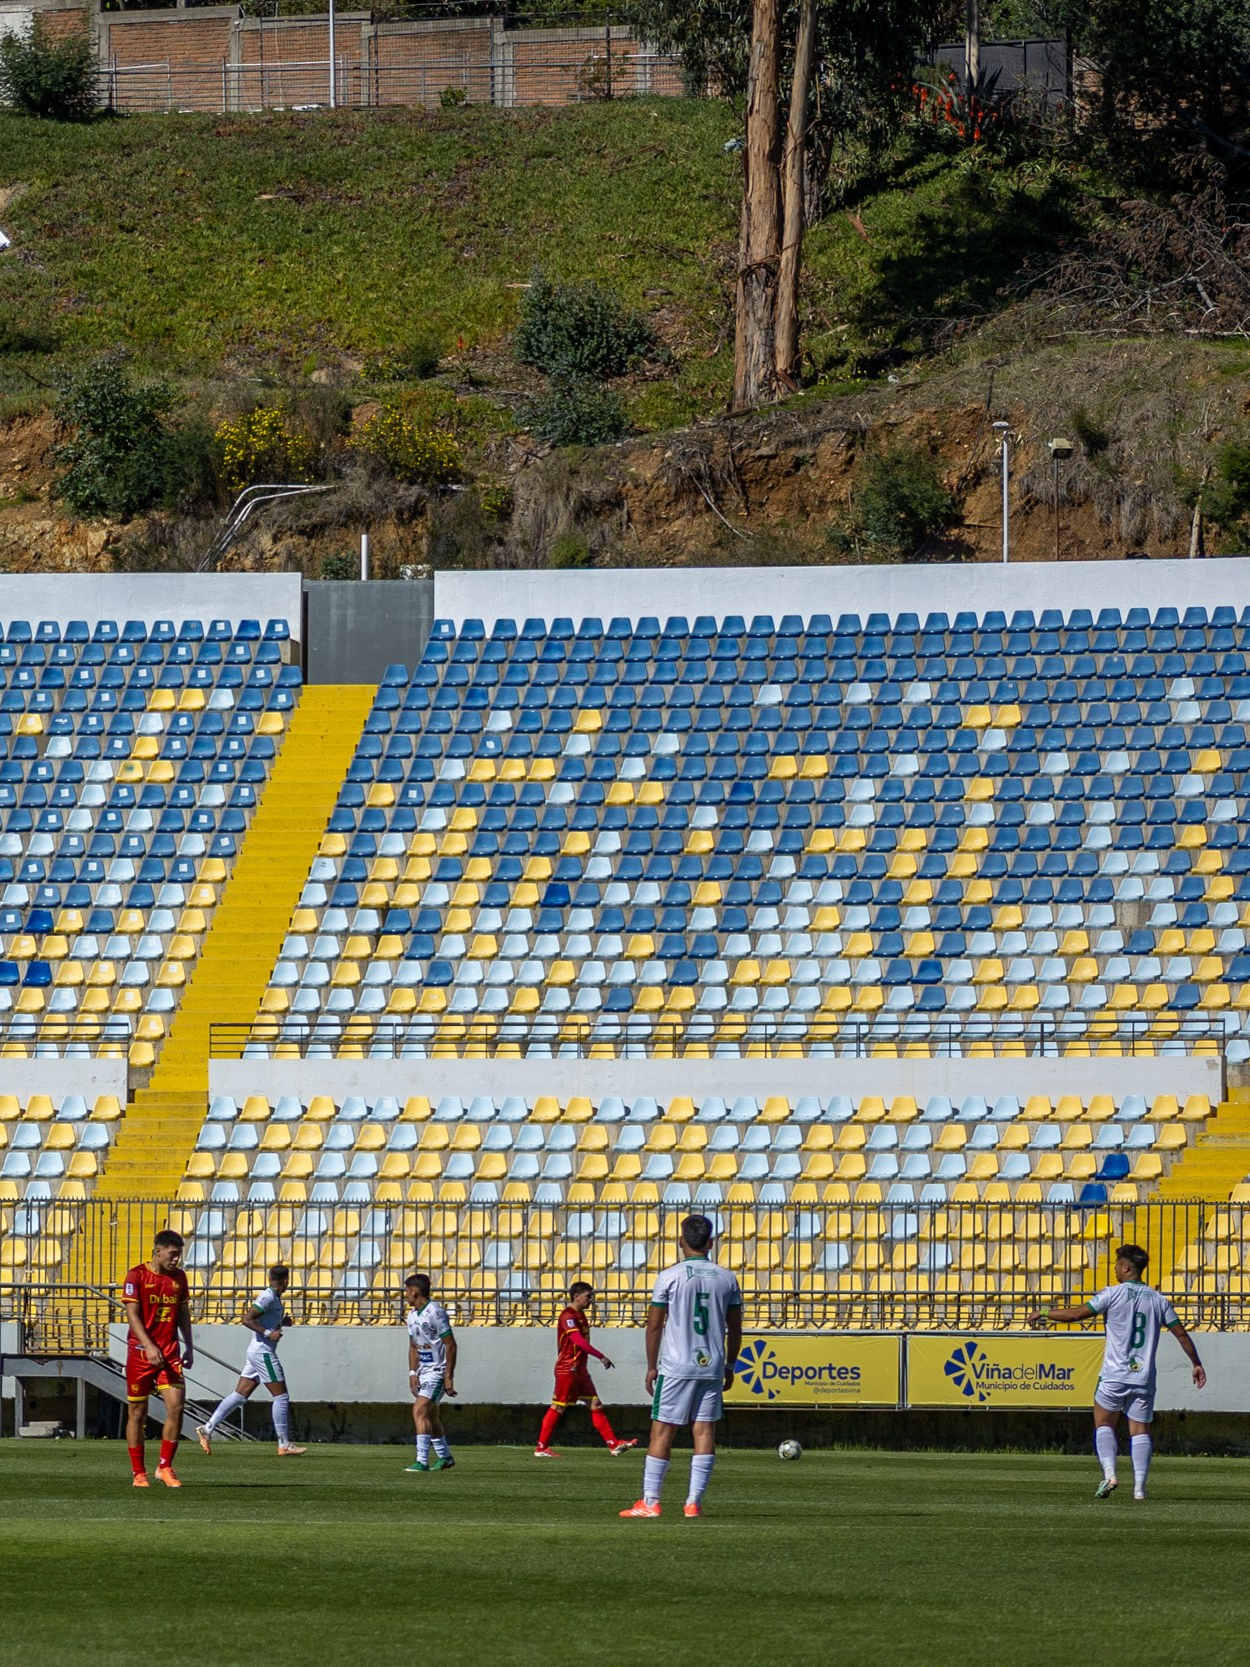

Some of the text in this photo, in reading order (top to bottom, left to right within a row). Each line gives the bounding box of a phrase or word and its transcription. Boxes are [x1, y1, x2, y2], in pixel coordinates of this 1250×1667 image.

[149, 1293, 178, 1304] Dubai
[693, 1292, 710, 1336] 5
[1130, 1311, 1147, 1349] 8
[762, 1361, 861, 1386] Deportes
[971, 1363, 1075, 1380] ViñadelMar
[976, 1381, 1075, 1392] Municipio de Cuidados
